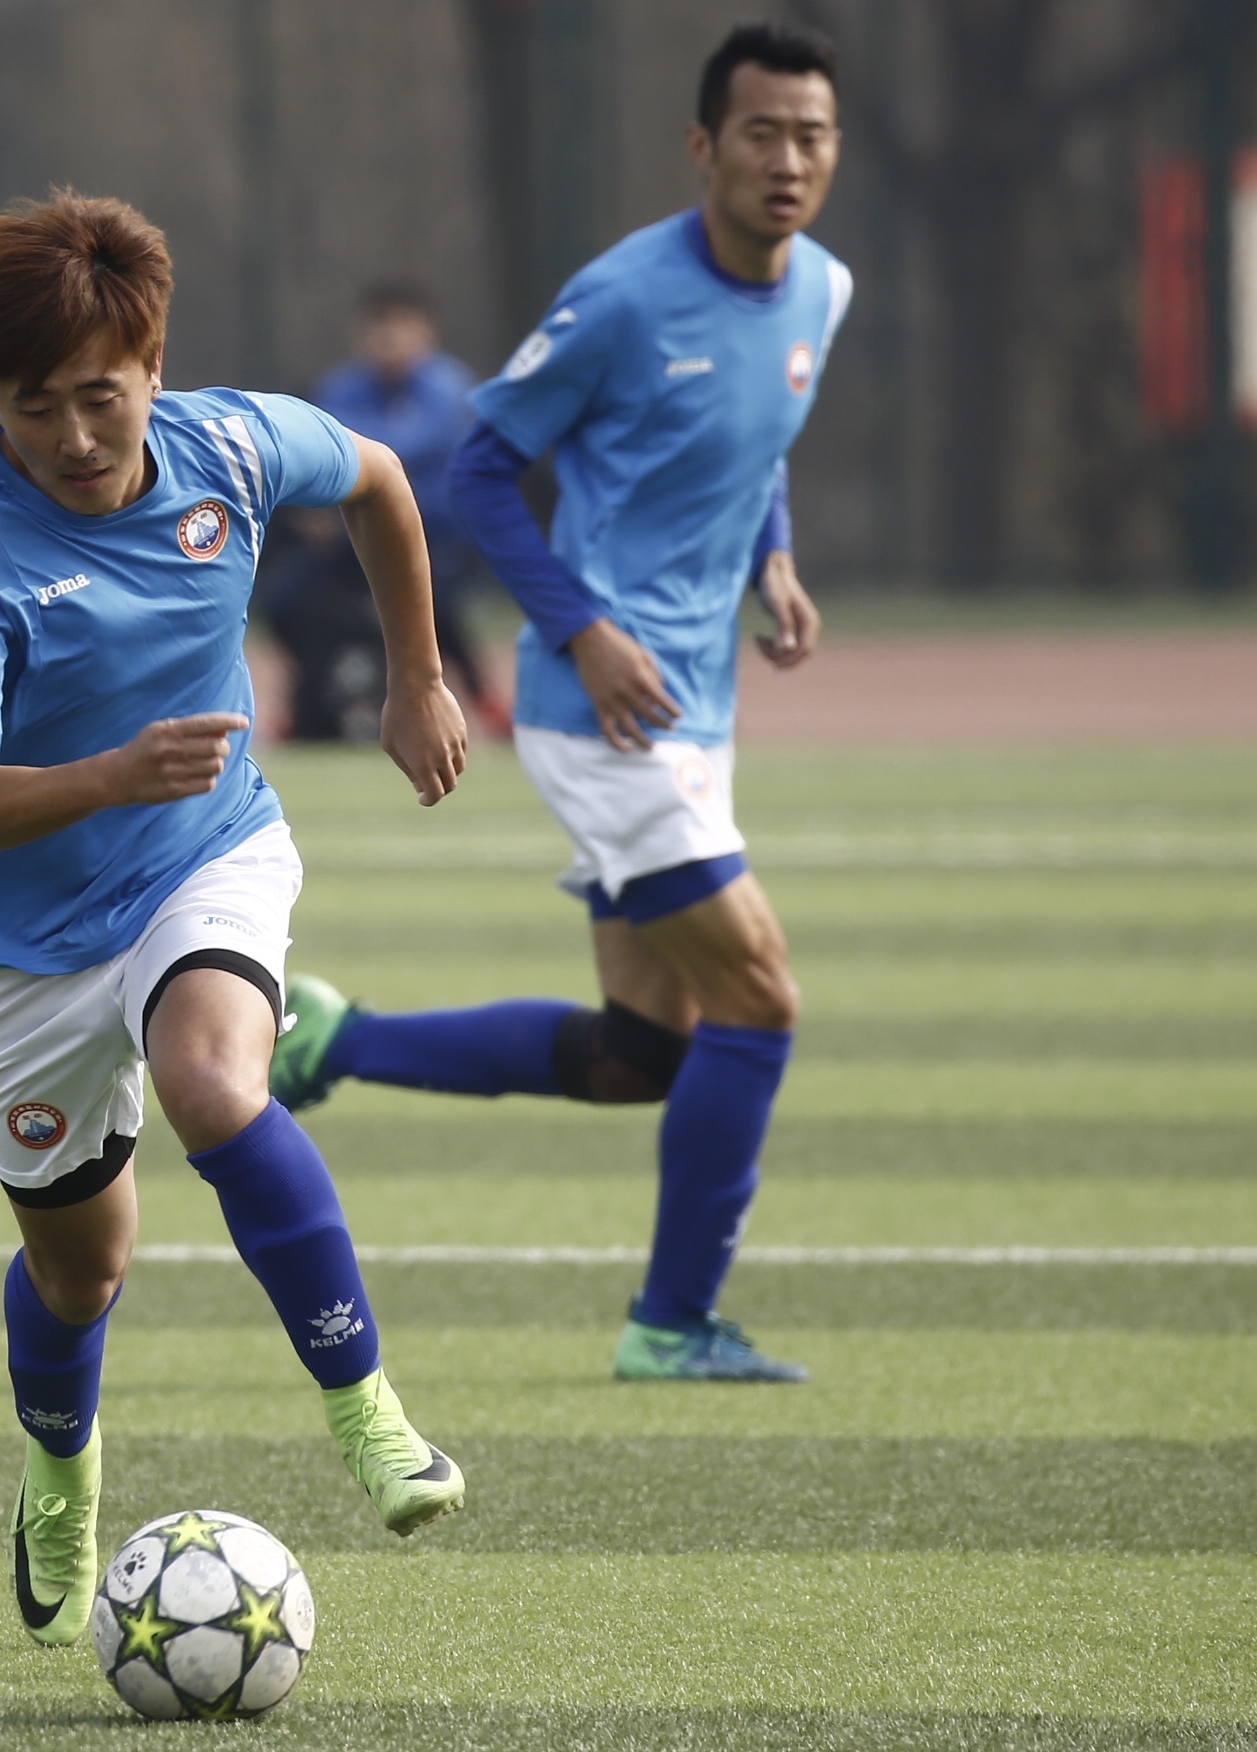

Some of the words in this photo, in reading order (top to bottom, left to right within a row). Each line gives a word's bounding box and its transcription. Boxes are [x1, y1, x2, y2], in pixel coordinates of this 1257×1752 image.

[38, 573, 91, 605] Joma
[203, 916, 257, 938] Joma
[310, 1318, 365, 1349] KELME
